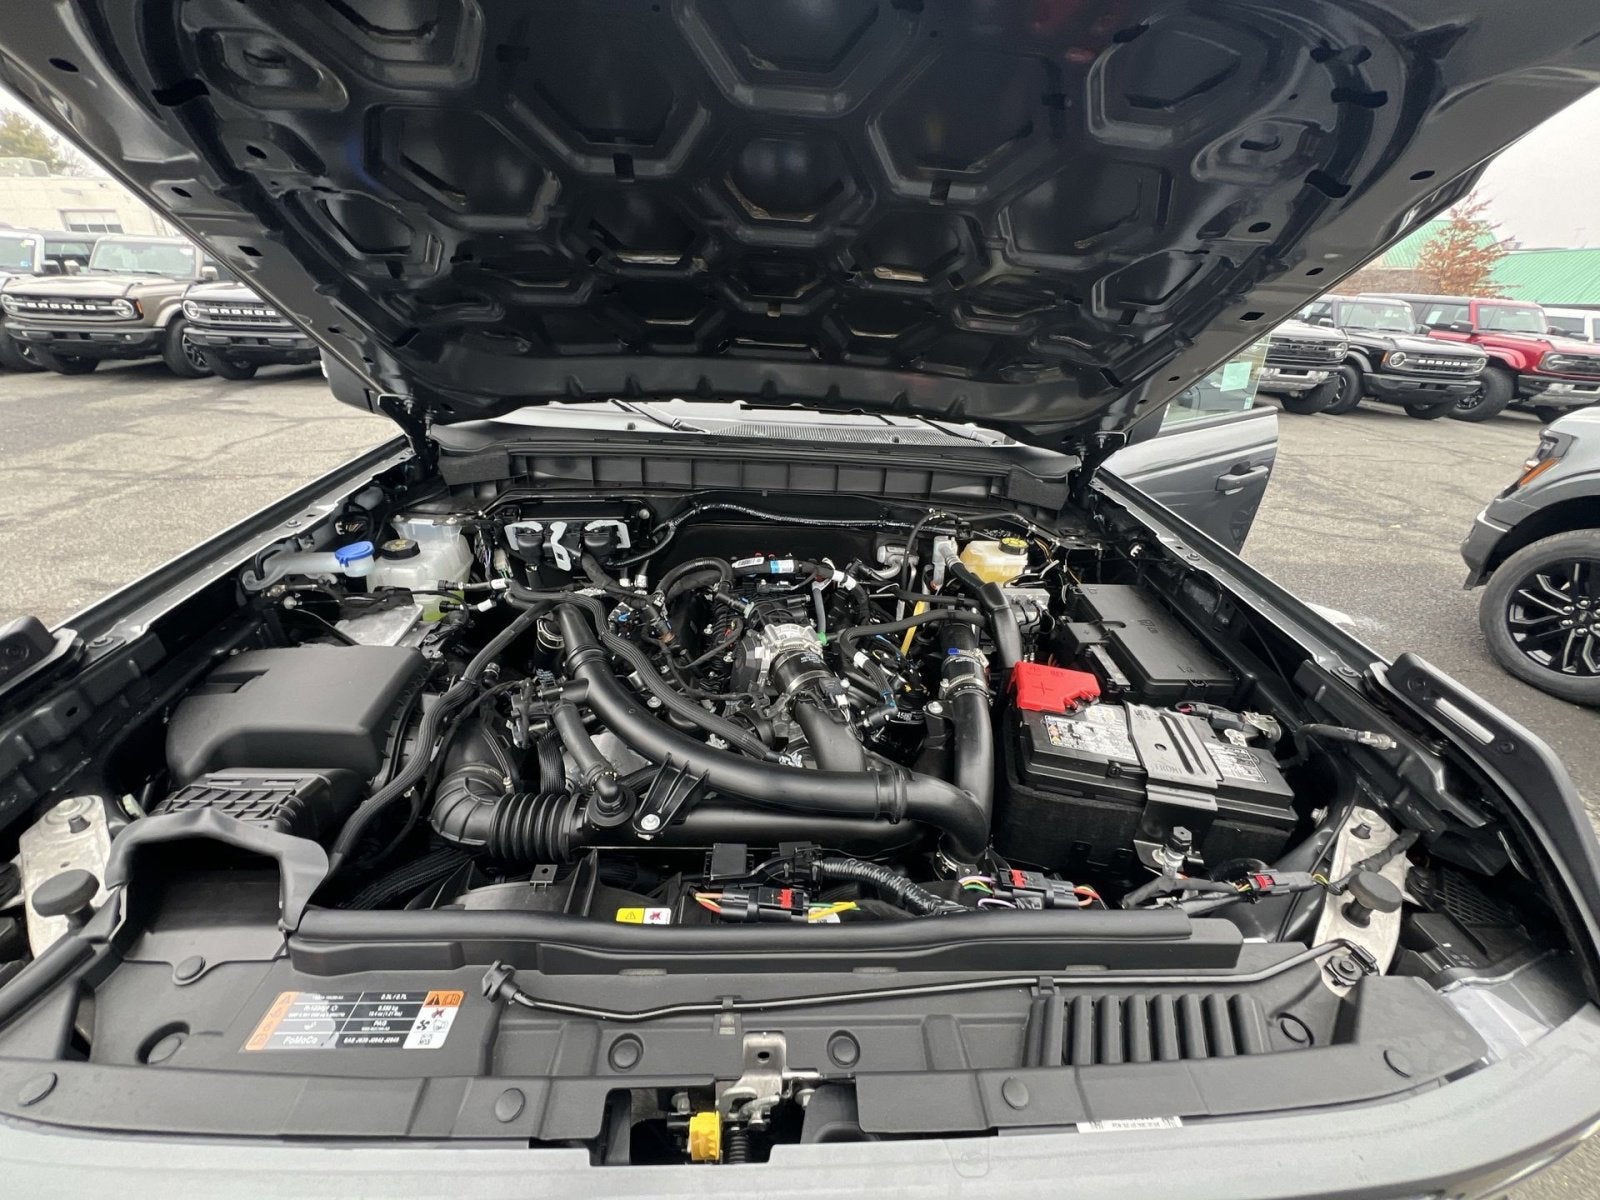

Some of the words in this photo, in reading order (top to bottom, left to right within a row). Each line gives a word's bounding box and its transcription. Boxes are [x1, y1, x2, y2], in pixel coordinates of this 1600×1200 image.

[26, 302, 97, 311] BRONCO
[208, 308, 276, 316] BRONCO
[1418, 359, 1468, 367] BRONCO
[282, 1035, 318, 1046] FoMoCo
